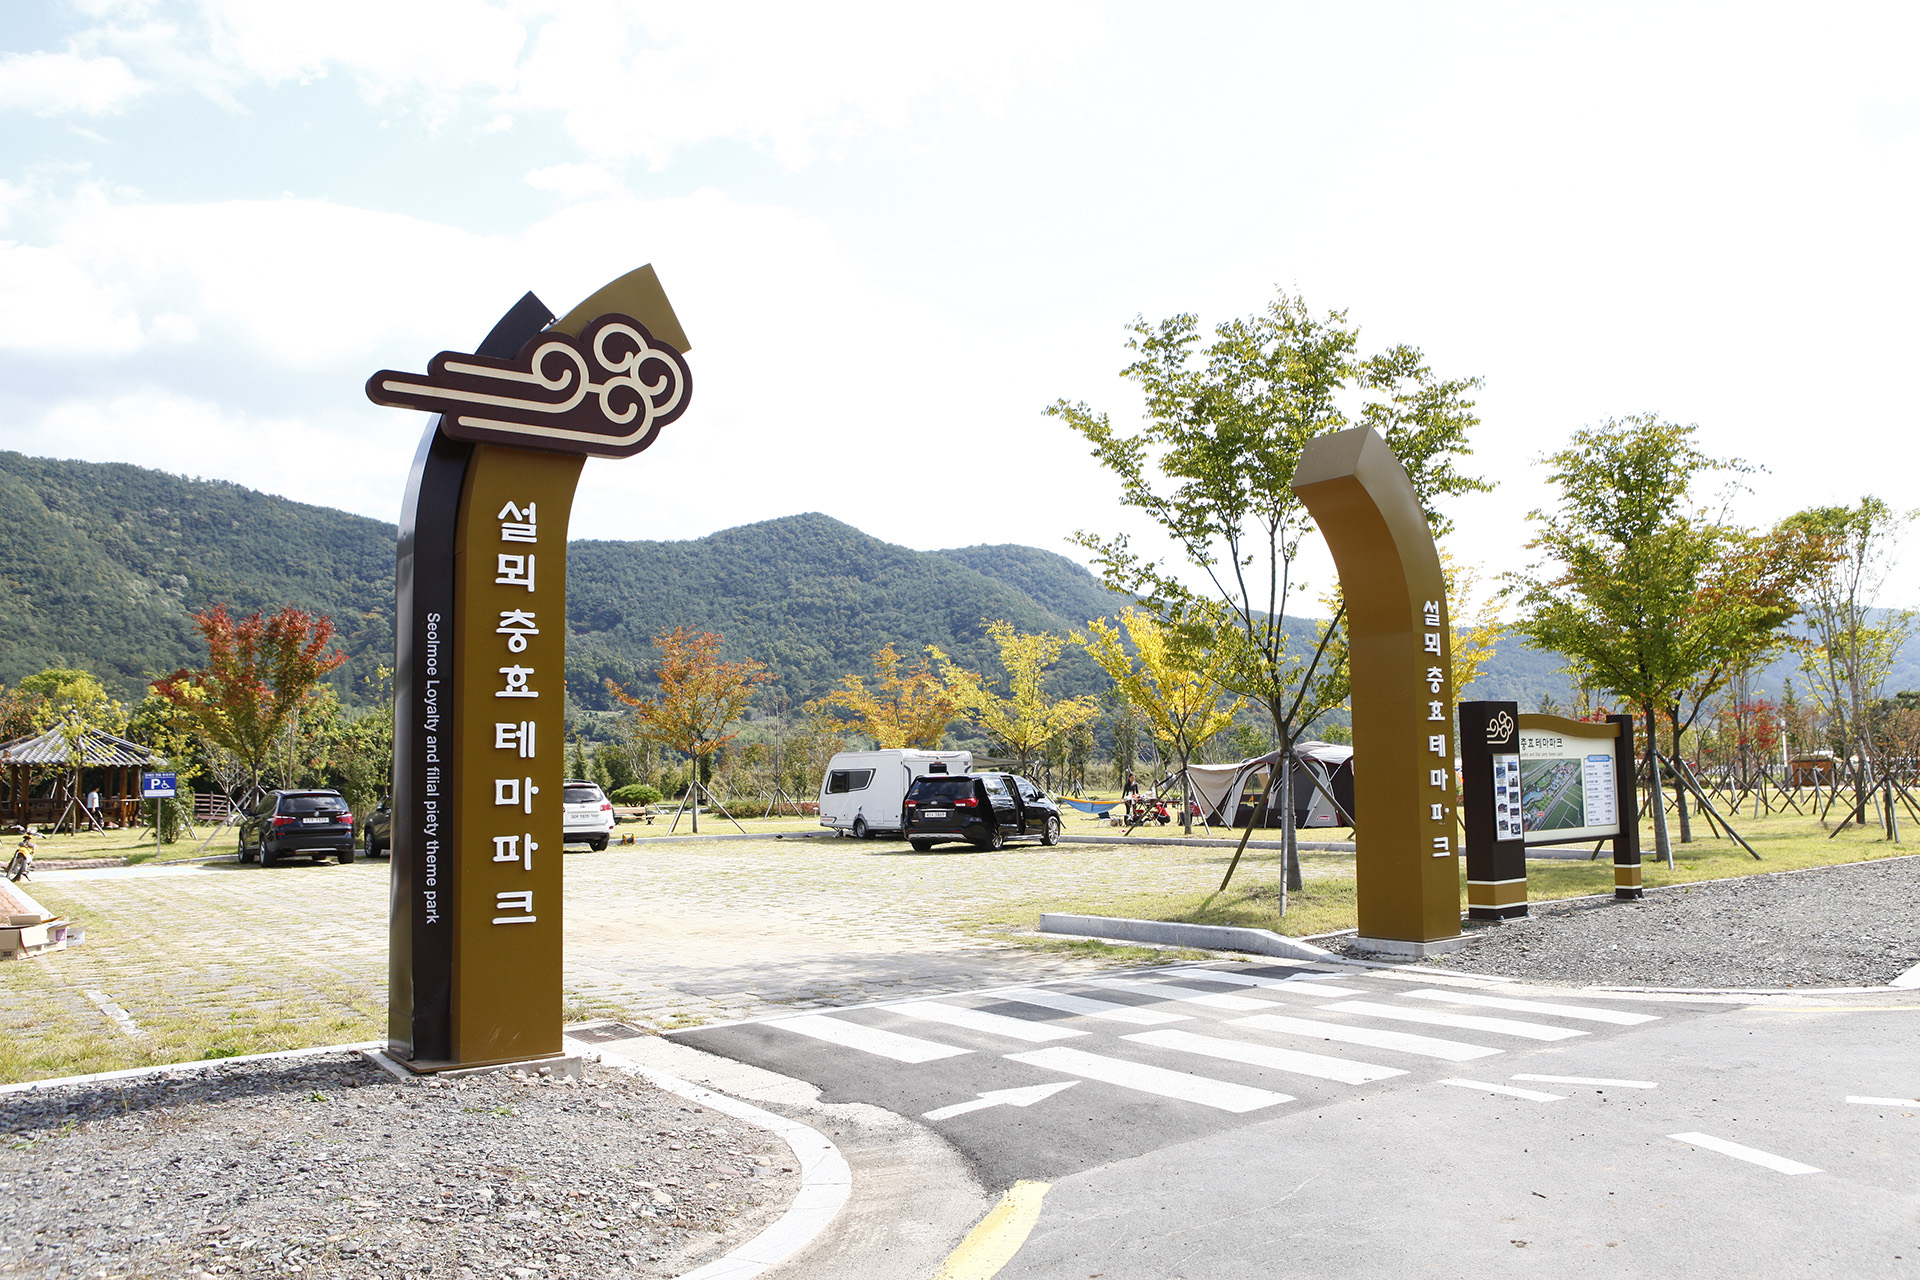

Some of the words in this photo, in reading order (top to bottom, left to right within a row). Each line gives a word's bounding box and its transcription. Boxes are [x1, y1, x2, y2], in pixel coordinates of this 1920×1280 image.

[426, 612, 441, 676] Seolmoe
[424, 680, 441, 732] Loyalty
[426, 735, 440, 763] and
[426, 766, 441, 797] filial
[424, 800, 440, 837] piety
[426, 840, 440, 887] theme
[424, 890, 440, 925] park
